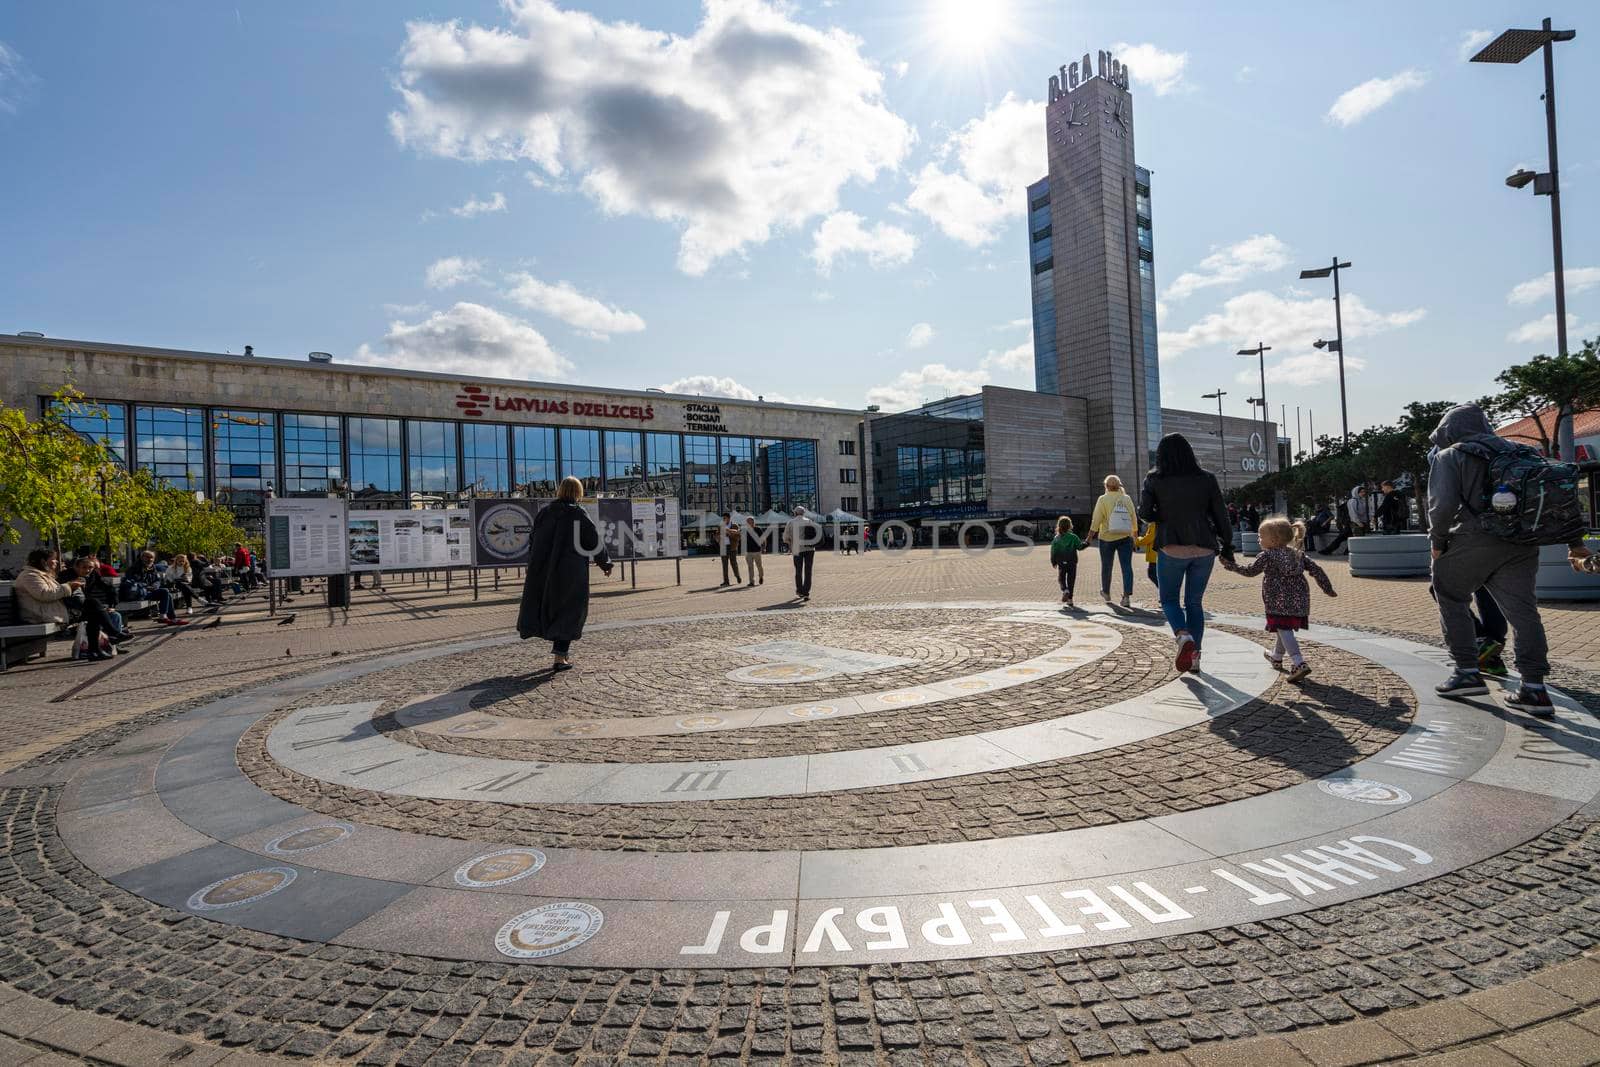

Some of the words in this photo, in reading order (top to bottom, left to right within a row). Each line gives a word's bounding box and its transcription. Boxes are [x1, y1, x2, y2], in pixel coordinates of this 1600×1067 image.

[495, 395, 569, 415] LATVIJAS
[572, 402, 655, 423] DZELZCEĻŠ
[686, 404, 720, 414] STACIJA
[686, 413, 721, 424] ВОКЗАЛ
[686, 422, 729, 433] TERMINAL
[886, 752, 930, 774] II
[661, 769, 733, 794] III
